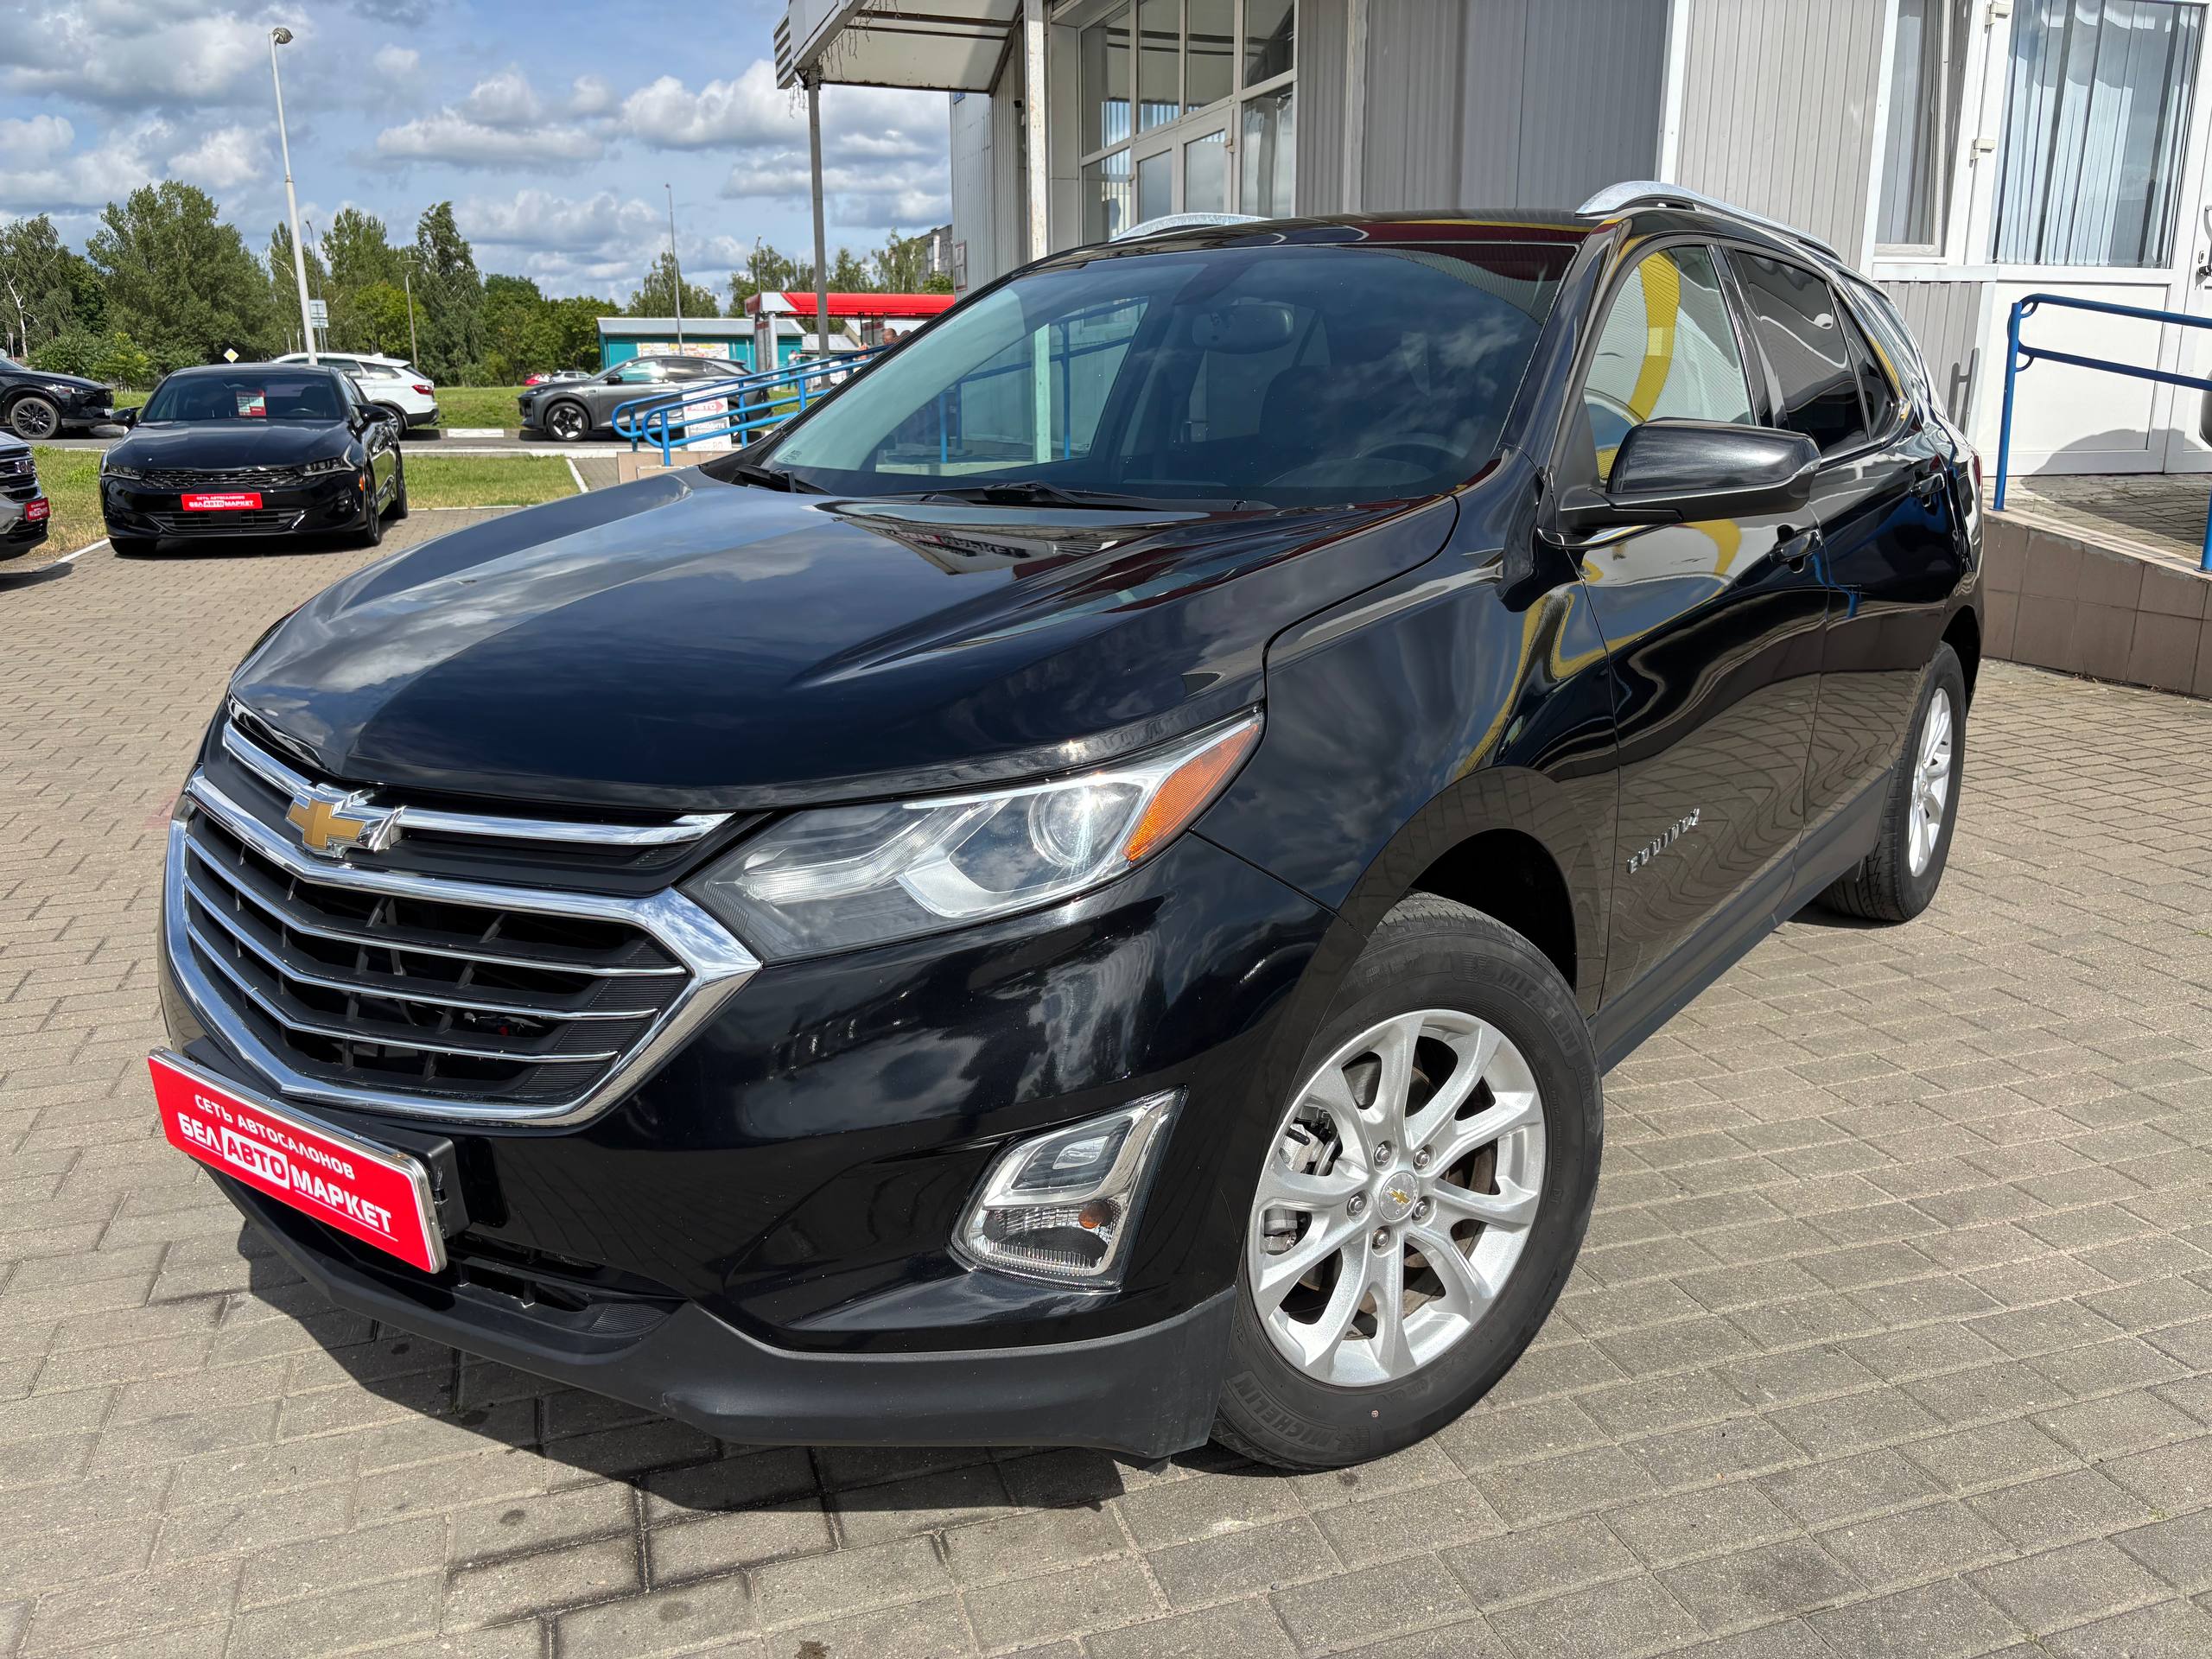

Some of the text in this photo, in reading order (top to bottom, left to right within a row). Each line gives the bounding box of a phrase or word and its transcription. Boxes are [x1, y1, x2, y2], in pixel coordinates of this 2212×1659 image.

[194, 1094, 356, 1180] СЕТЬ АВТОСАЛОНОВ
[1234, 1379, 1333, 1447] MICHELIN
